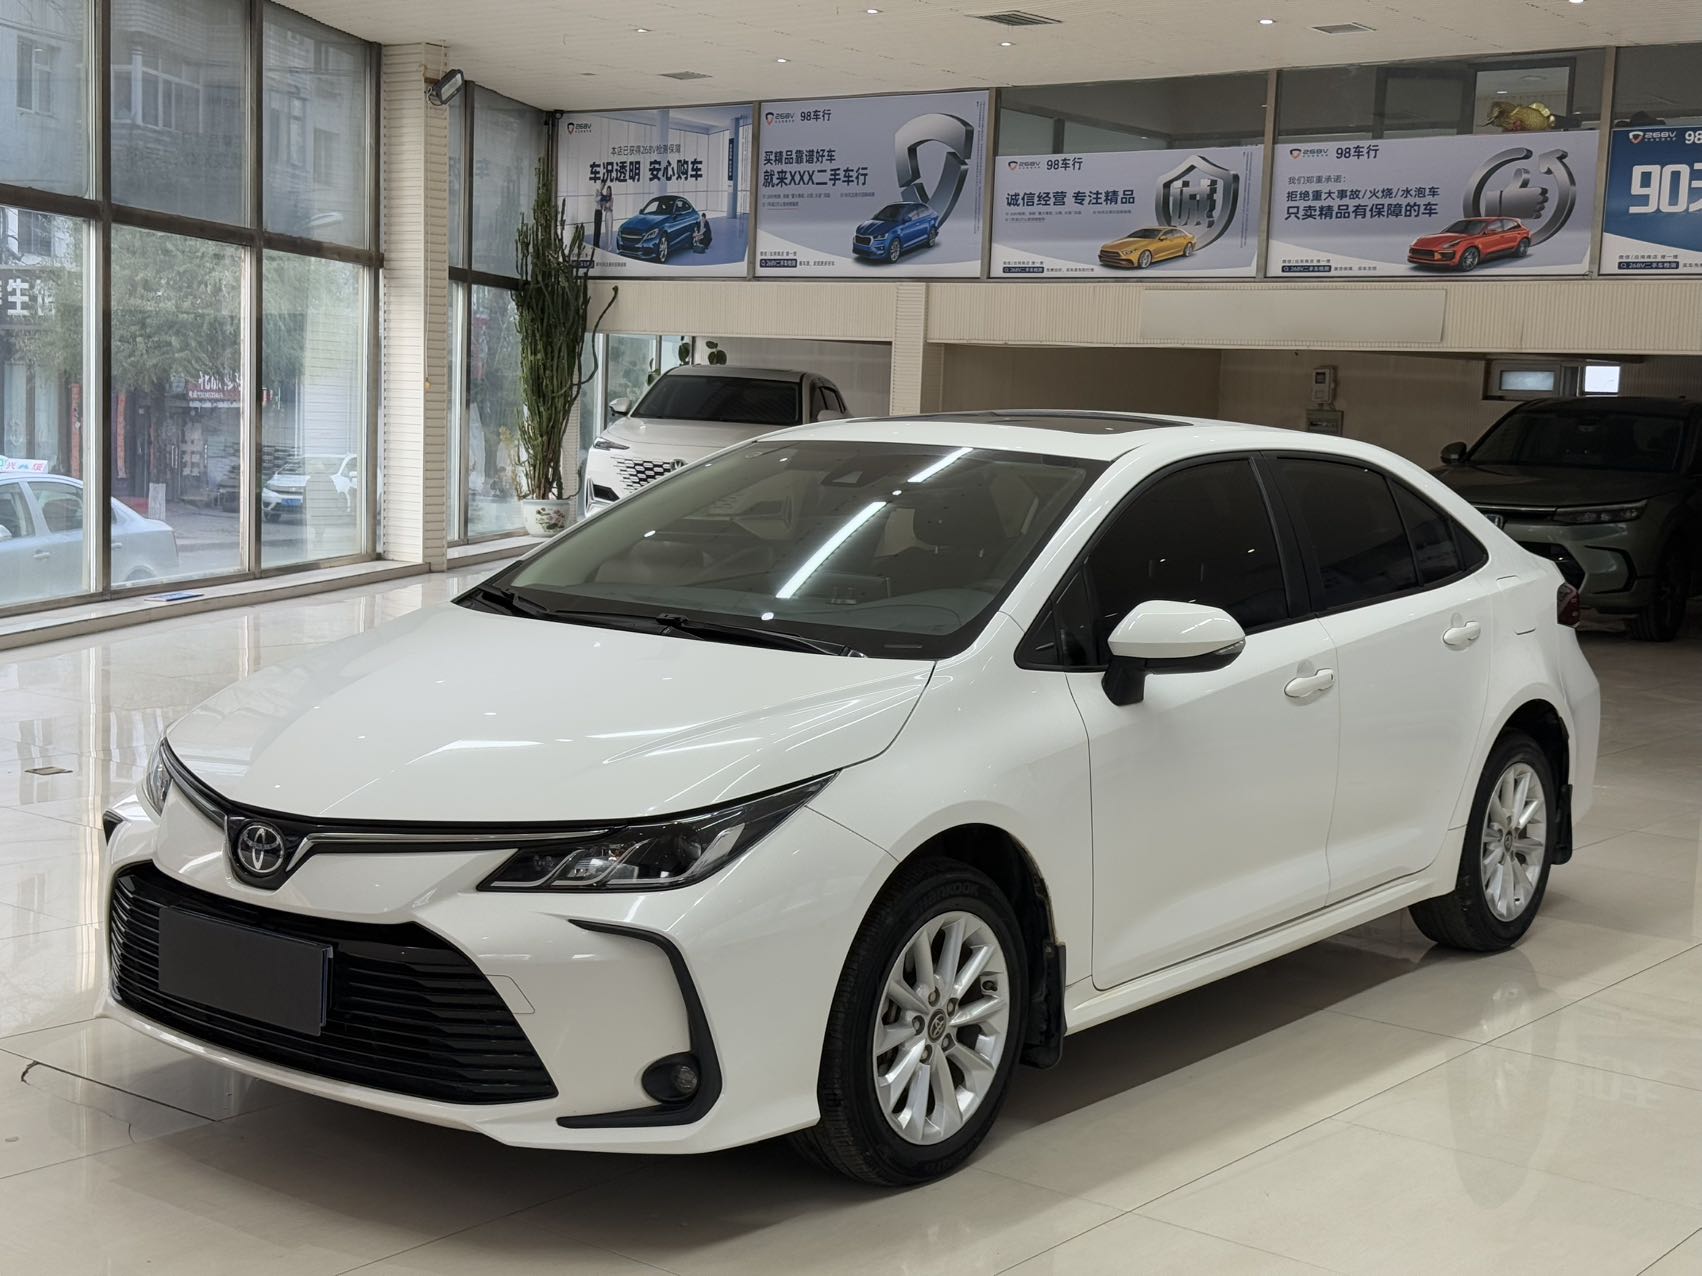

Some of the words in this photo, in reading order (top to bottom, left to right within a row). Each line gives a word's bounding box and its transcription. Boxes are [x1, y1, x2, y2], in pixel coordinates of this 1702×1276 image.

[800, 109, 831, 122] 98车行
[1685, 131, 1702, 144] 98
[764, 148, 836, 166] 买精品靠谱好车
[1336, 144, 1379, 159] 98车行
[589, 161, 640, 183] 车况透明
[649, 158, 703, 182] 安心购车
[1046, 157, 1083, 171] 98车行
[763, 167, 868, 188] 就来XXX二手车行
[1006, 191, 1067, 207] 诚信经营
[1072, 189, 1135, 206] 专注精品
[1286, 186, 1440, 202] 拒绝重大事故/火烧/水泡车
[1285, 202, 1438, 220] 只卖精品有保障的车
